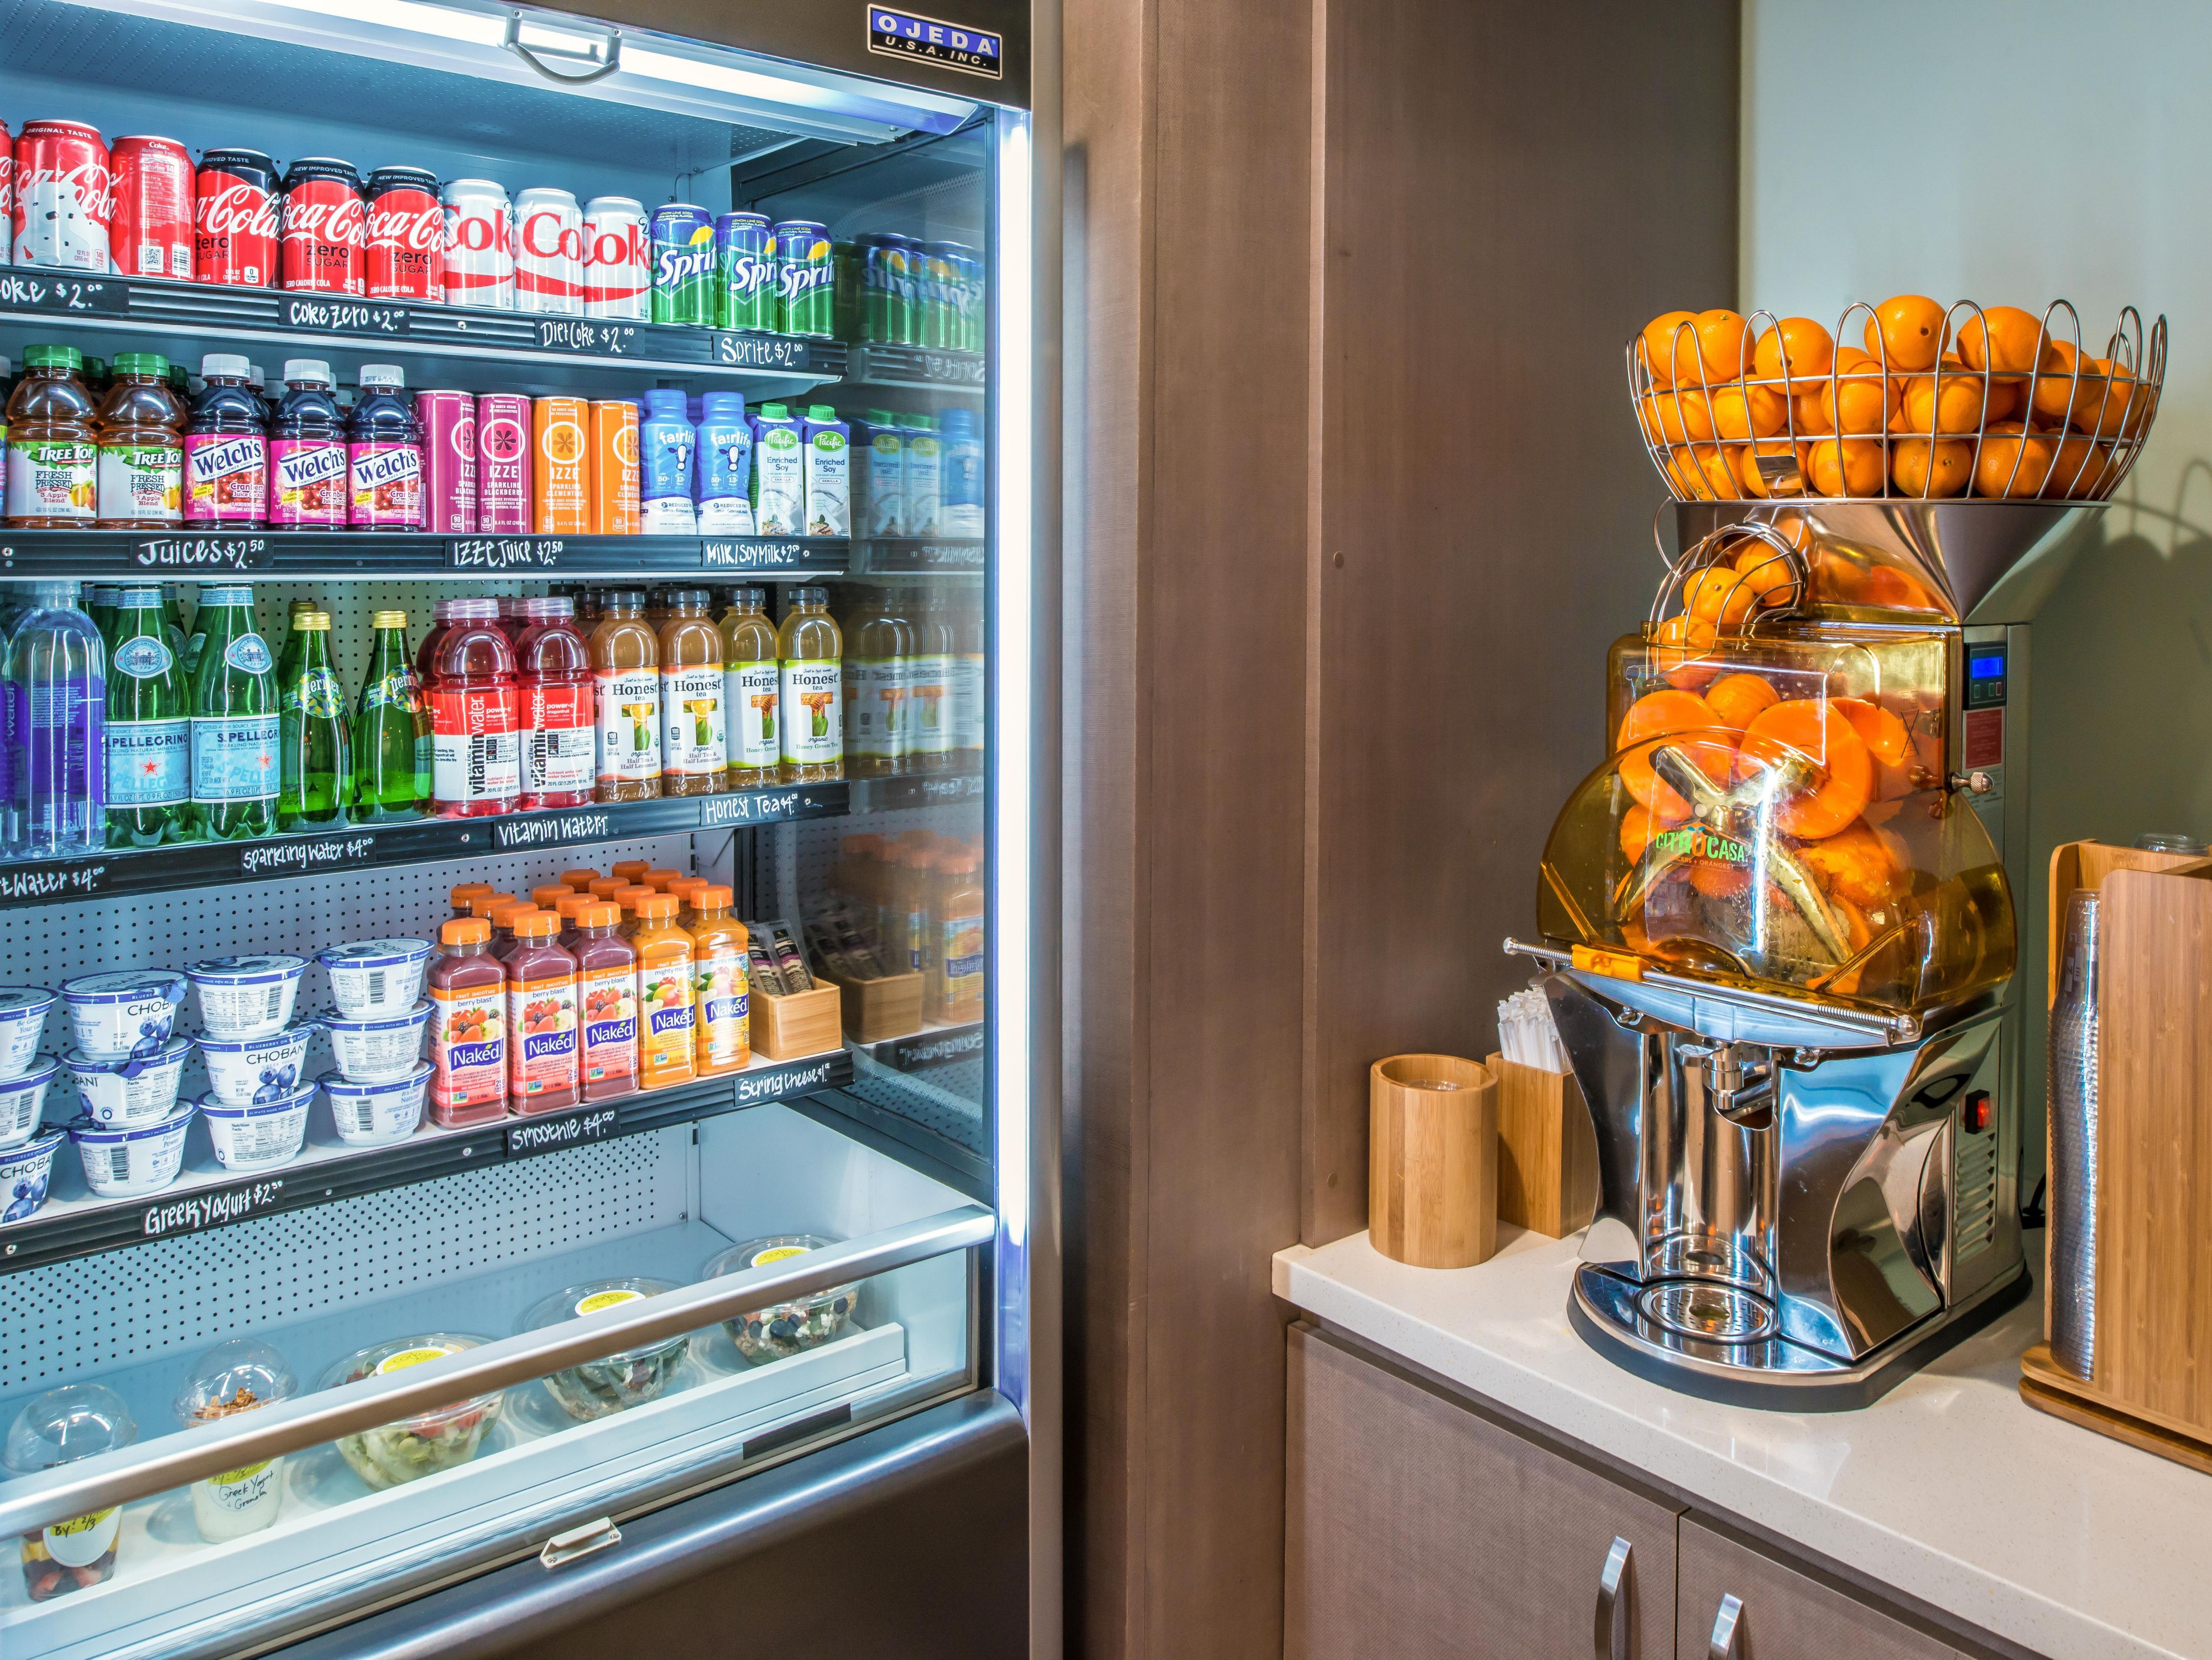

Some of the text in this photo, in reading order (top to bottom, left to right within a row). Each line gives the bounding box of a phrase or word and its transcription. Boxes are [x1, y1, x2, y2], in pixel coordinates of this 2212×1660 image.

[878, 15, 993, 55] OJEDA
[885, 36, 987, 66] U.S.A. INC.
[67, 129, 92, 139] TASTE
[149, 141, 168, 150] Coke
[444, 204, 513, 258] Cok
[523, 212, 582, 261] Co
[195, 237, 229, 250] zero
[306, 244, 349, 258] zero
[307, 258, 348, 268] SUGAR
[391, 252, 432, 265] zero
[392, 264, 431, 275] SUGAR
[655, 246, 717, 291] Sprit
[776, 260, 834, 302] Sprit
[0, 276, 103, 309] oke $2.00
[373, 310, 404, 331] $2.00
[540, 321, 634, 353] Diet Coke $2.00
[721, 337, 803, 366] Sprite $2.00
[767, 431, 794, 447] Pacific
[816, 434, 842, 449] Pacific
[38, 445, 93, 461] TREE TOP
[132, 451, 165, 466] TREE
[194, 440, 262, 476] Welch's
[283, 449, 345, 483] Welch's
[356, 450, 417, 484] Welch's
[489, 465, 518, 478] IZZE
[35, 471, 73, 480] FRESH
[130, 475, 165, 483] FRESH
[550, 467, 579, 480] IZZE
[35, 480, 73, 490] PRESSED
[130, 483, 165, 492] PRESSED
[138, 539, 264, 569] Juices $2.50
[498, 539, 531, 568] Juice
[536, 540, 563, 565] $2.50
[674, 678, 722, 692] Honest
[792, 673, 838, 685] Honest
[612, 683, 658, 696] Honest
[468, 734, 485, 796] vitamin
[531, 729, 546, 788] vitamin
[706, 796, 749, 824] Honest
[753, 795, 780, 818] Tea
[347, 837, 373, 857] $4.00
[1655, 830, 1745, 863] CITROCASA
[1699, 859, 1730, 870] ORANGES
[728, 955, 745, 964] mango
[655, 967, 674, 976] mighty
[594, 978, 611, 987] berry
[533, 988, 549, 998] berry
[457, 998, 475, 1007] berry
[249, 1041, 279, 1049] BLUEBERRY
[401, 1094, 420, 1104] Natural
[164, 1138, 180, 1148] Power
[4, 1151, 37, 1162] BLUEBERRY
[144, 1180, 283, 1235] Greek Yogurt $2.50
[219, 1483, 248, 1501] Greek
